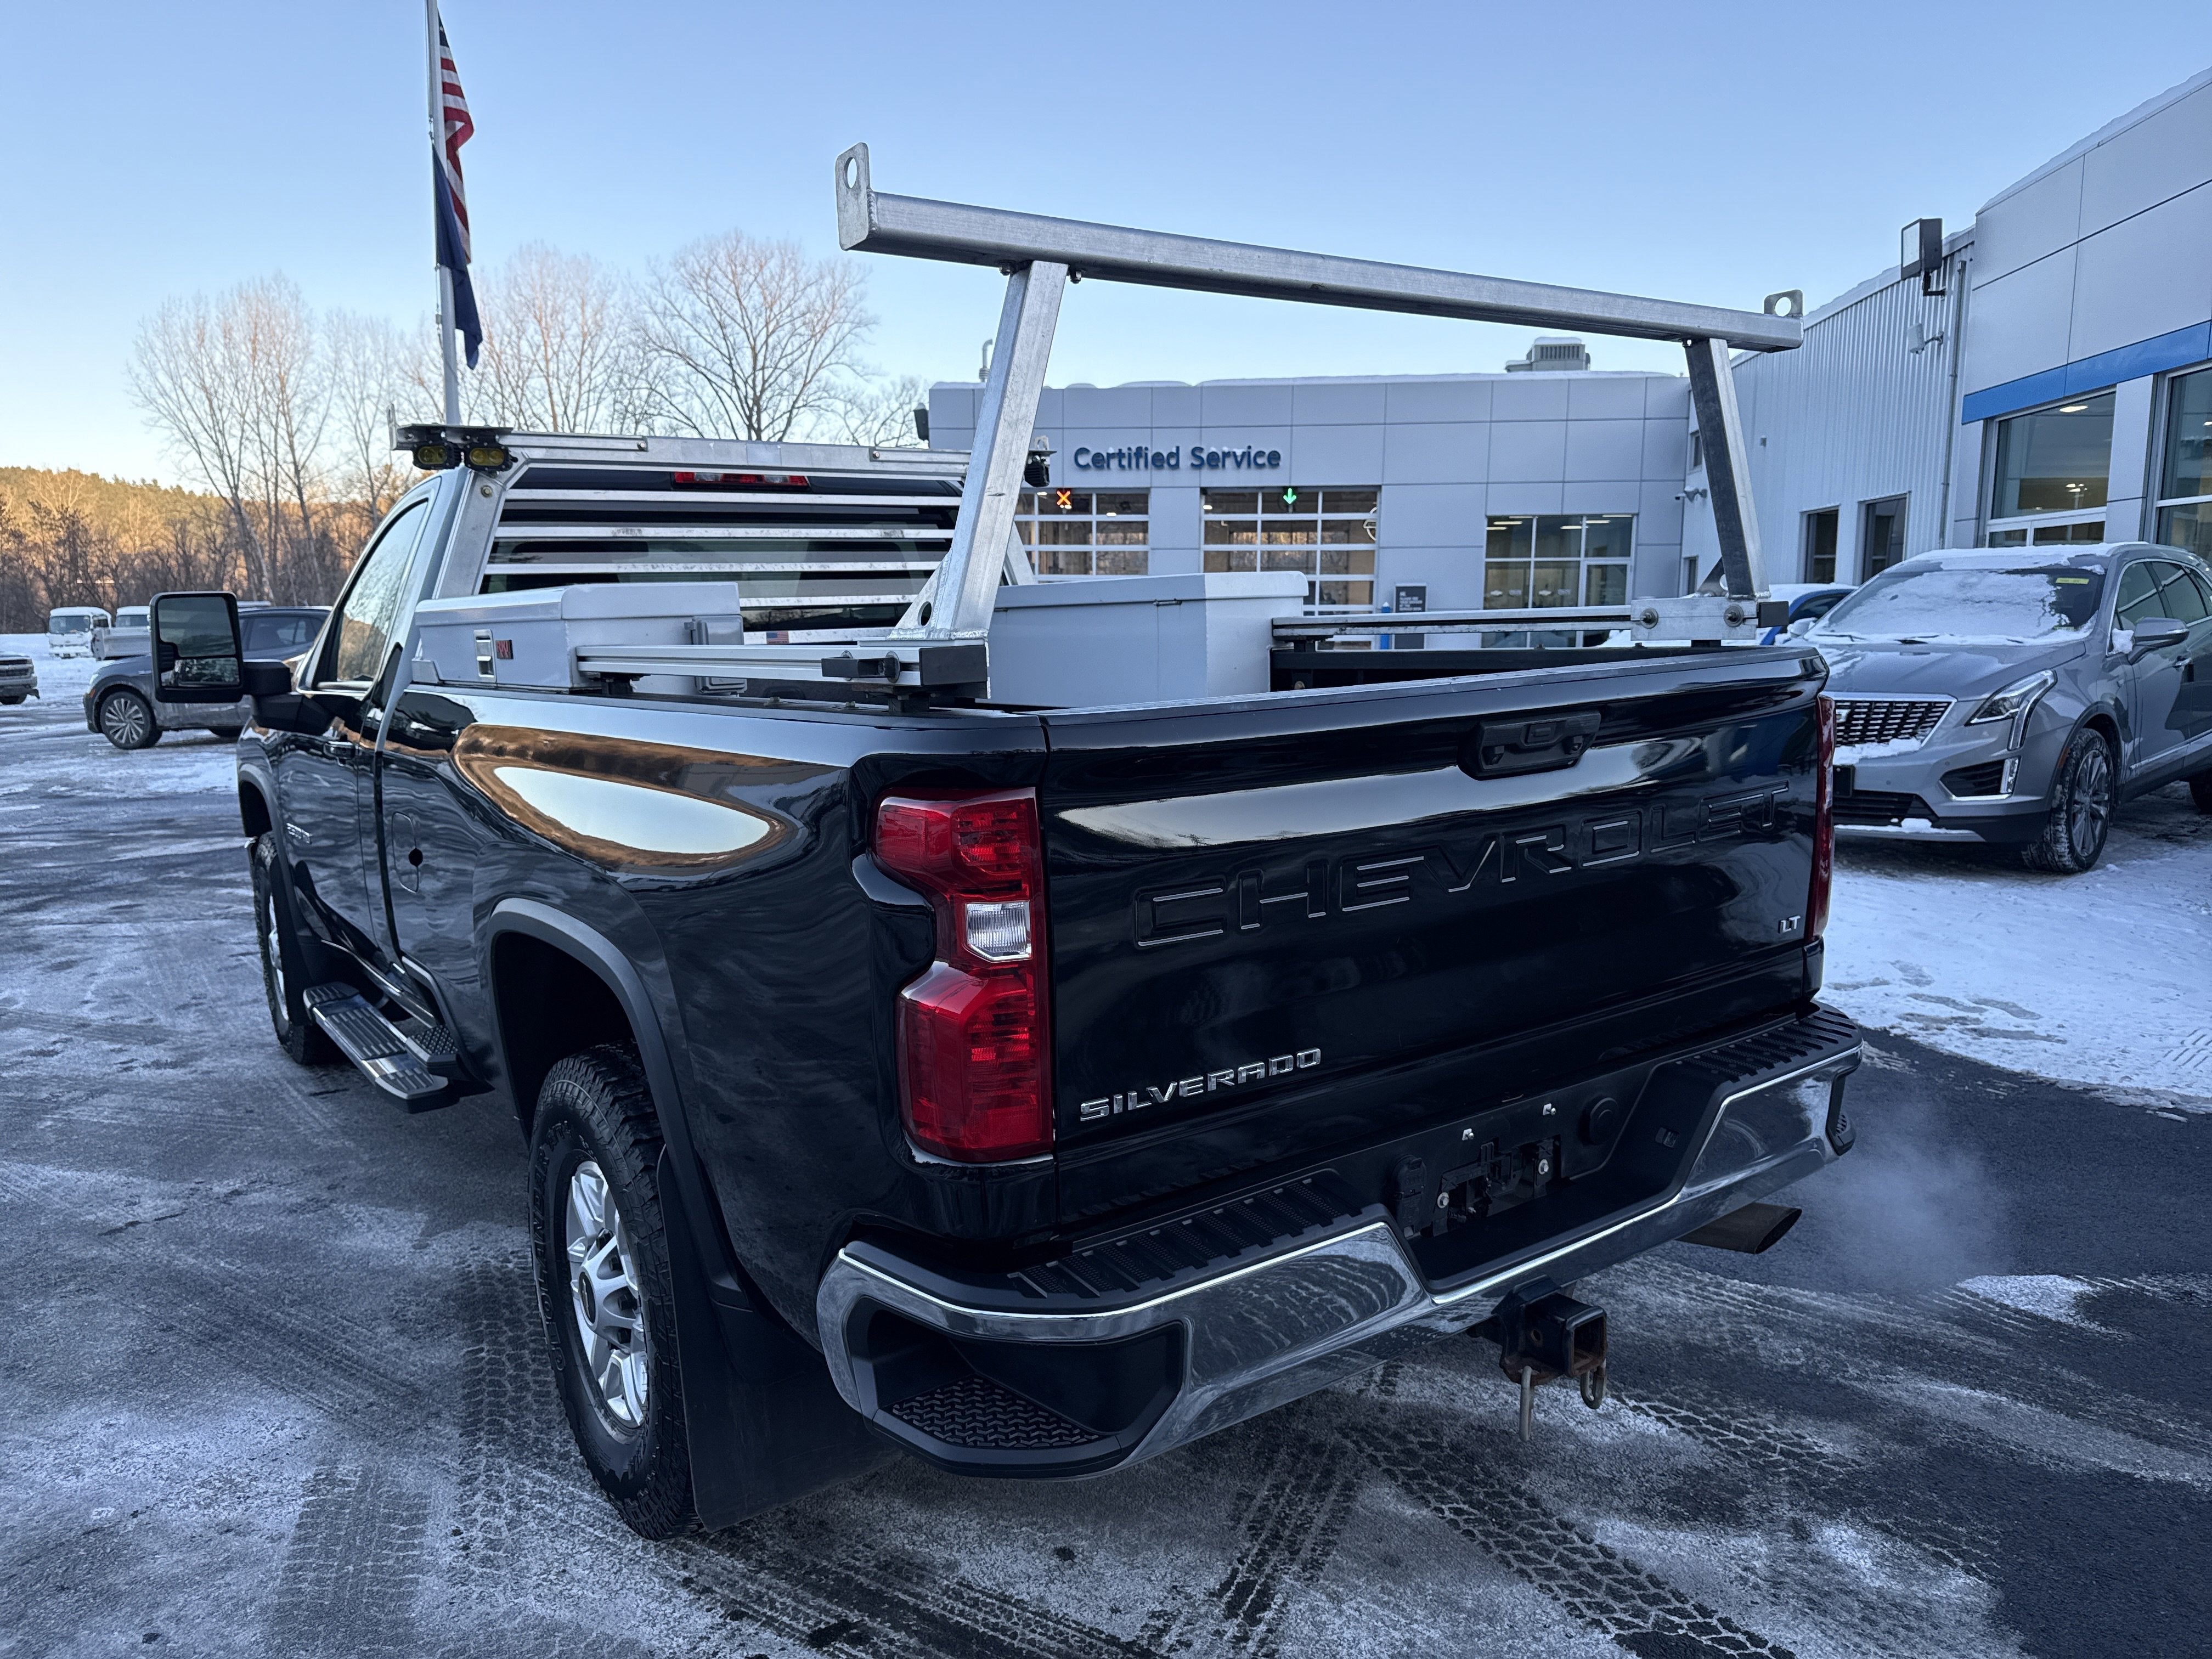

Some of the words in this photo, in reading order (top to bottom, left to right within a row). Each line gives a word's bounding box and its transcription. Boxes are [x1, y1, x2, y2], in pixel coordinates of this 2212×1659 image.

[1074, 445, 1180, 470] Certified
[1190, 445, 1281, 470] Service
[1134, 780, 1790, 948] CHEVROLET
[1779, 915, 1801, 933] LT
[1080, 1047, 1321, 1122] SILVERADO
